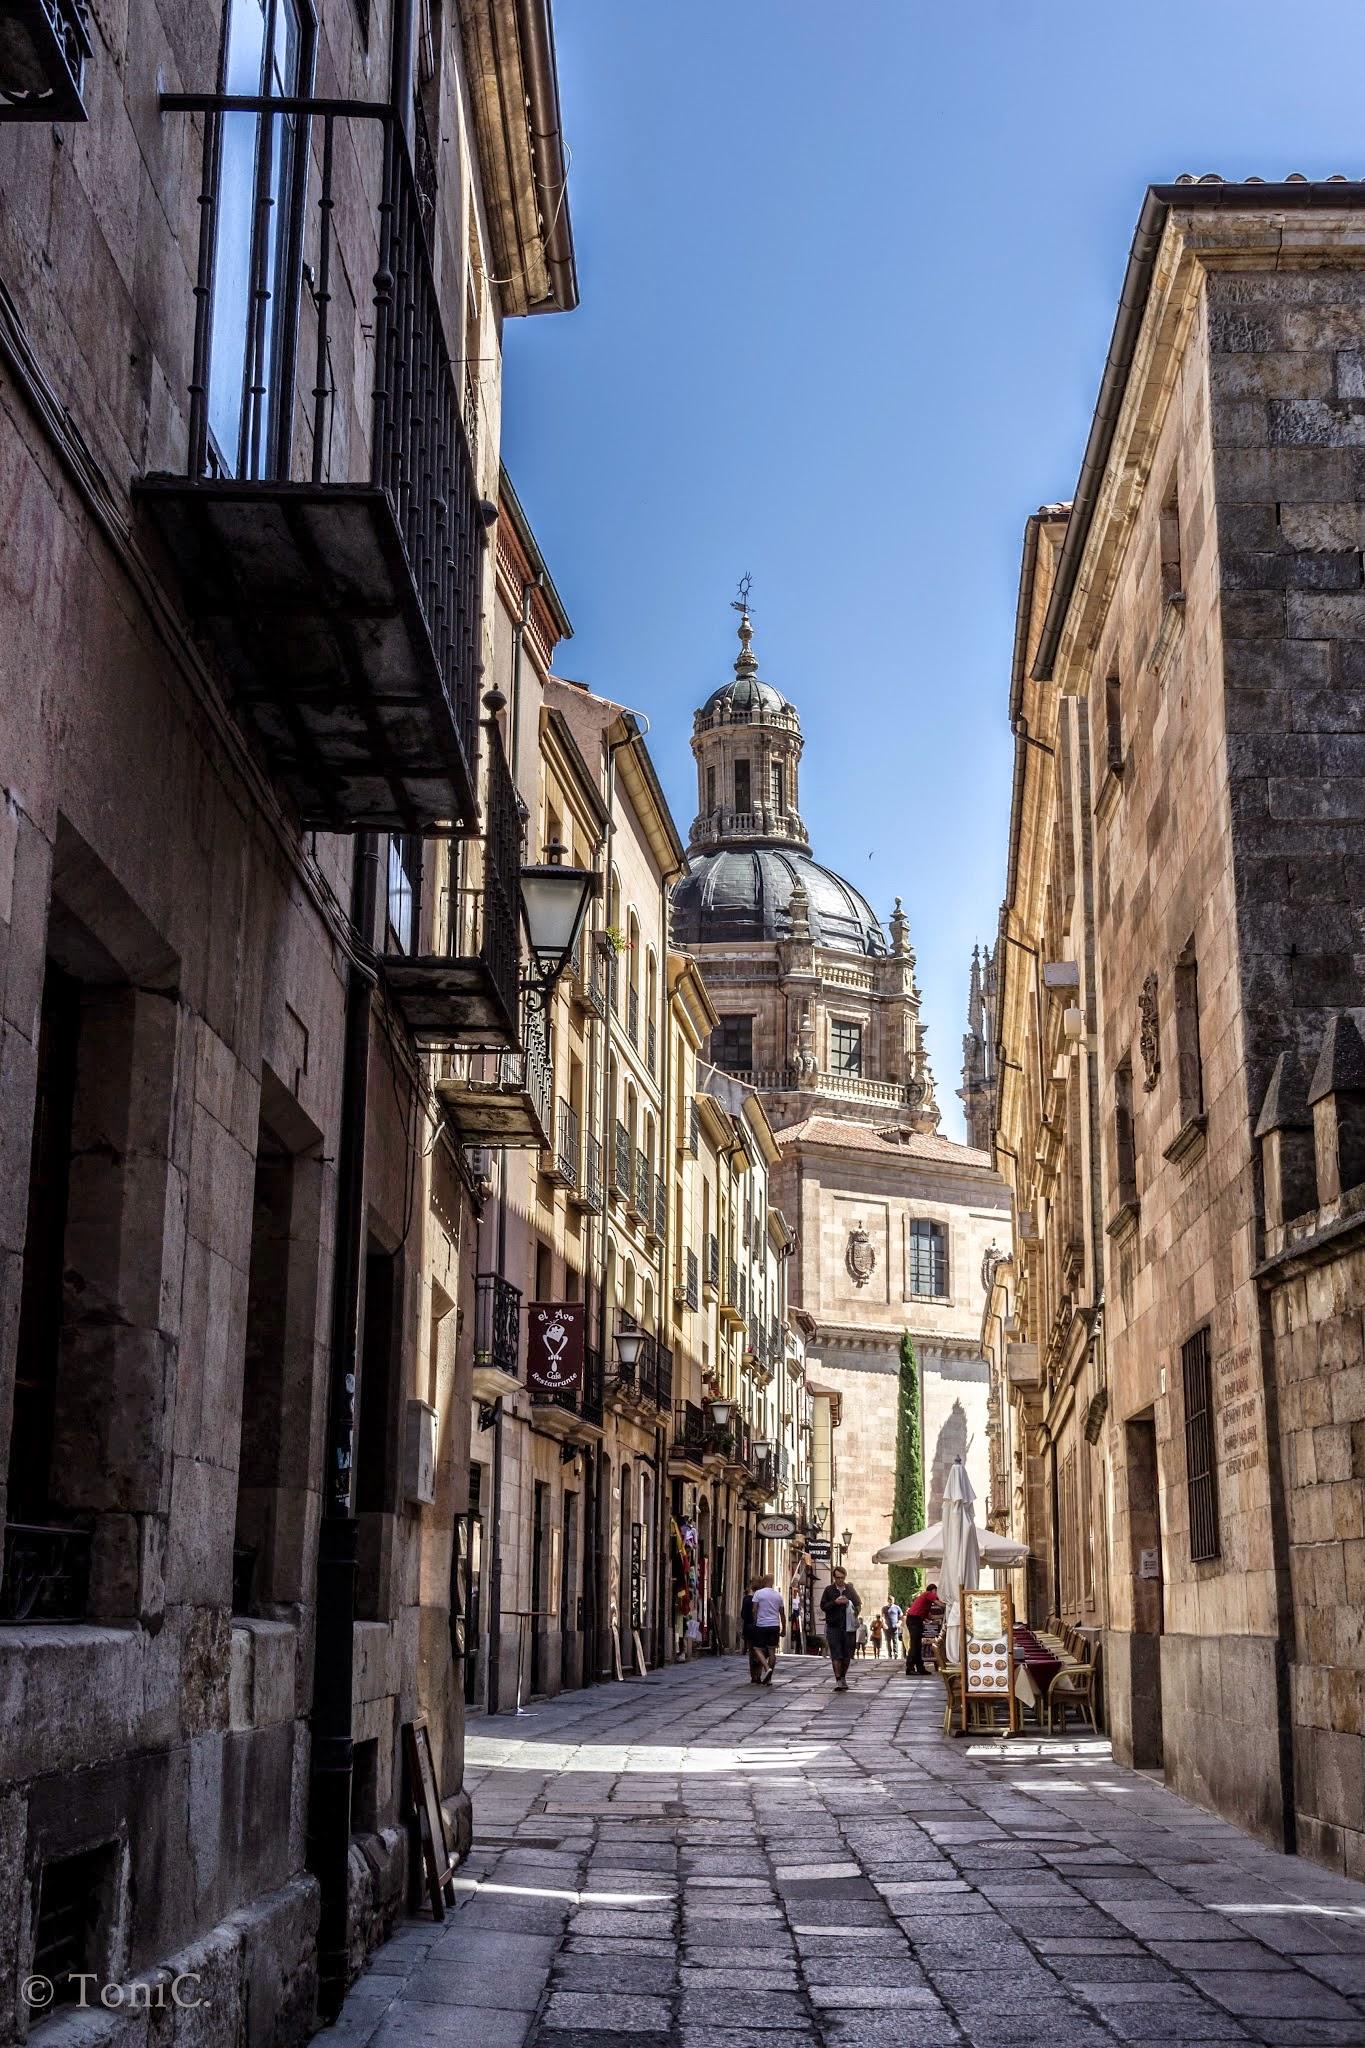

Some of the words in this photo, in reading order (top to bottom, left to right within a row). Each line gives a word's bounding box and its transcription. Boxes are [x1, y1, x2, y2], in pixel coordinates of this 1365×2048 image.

[538, 1309, 548, 1321] el
[554, 1309, 575, 1322] Ave
[532, 1372, 578, 1387] Restaurante
[761, 1523, 790, 1532] VALOR
